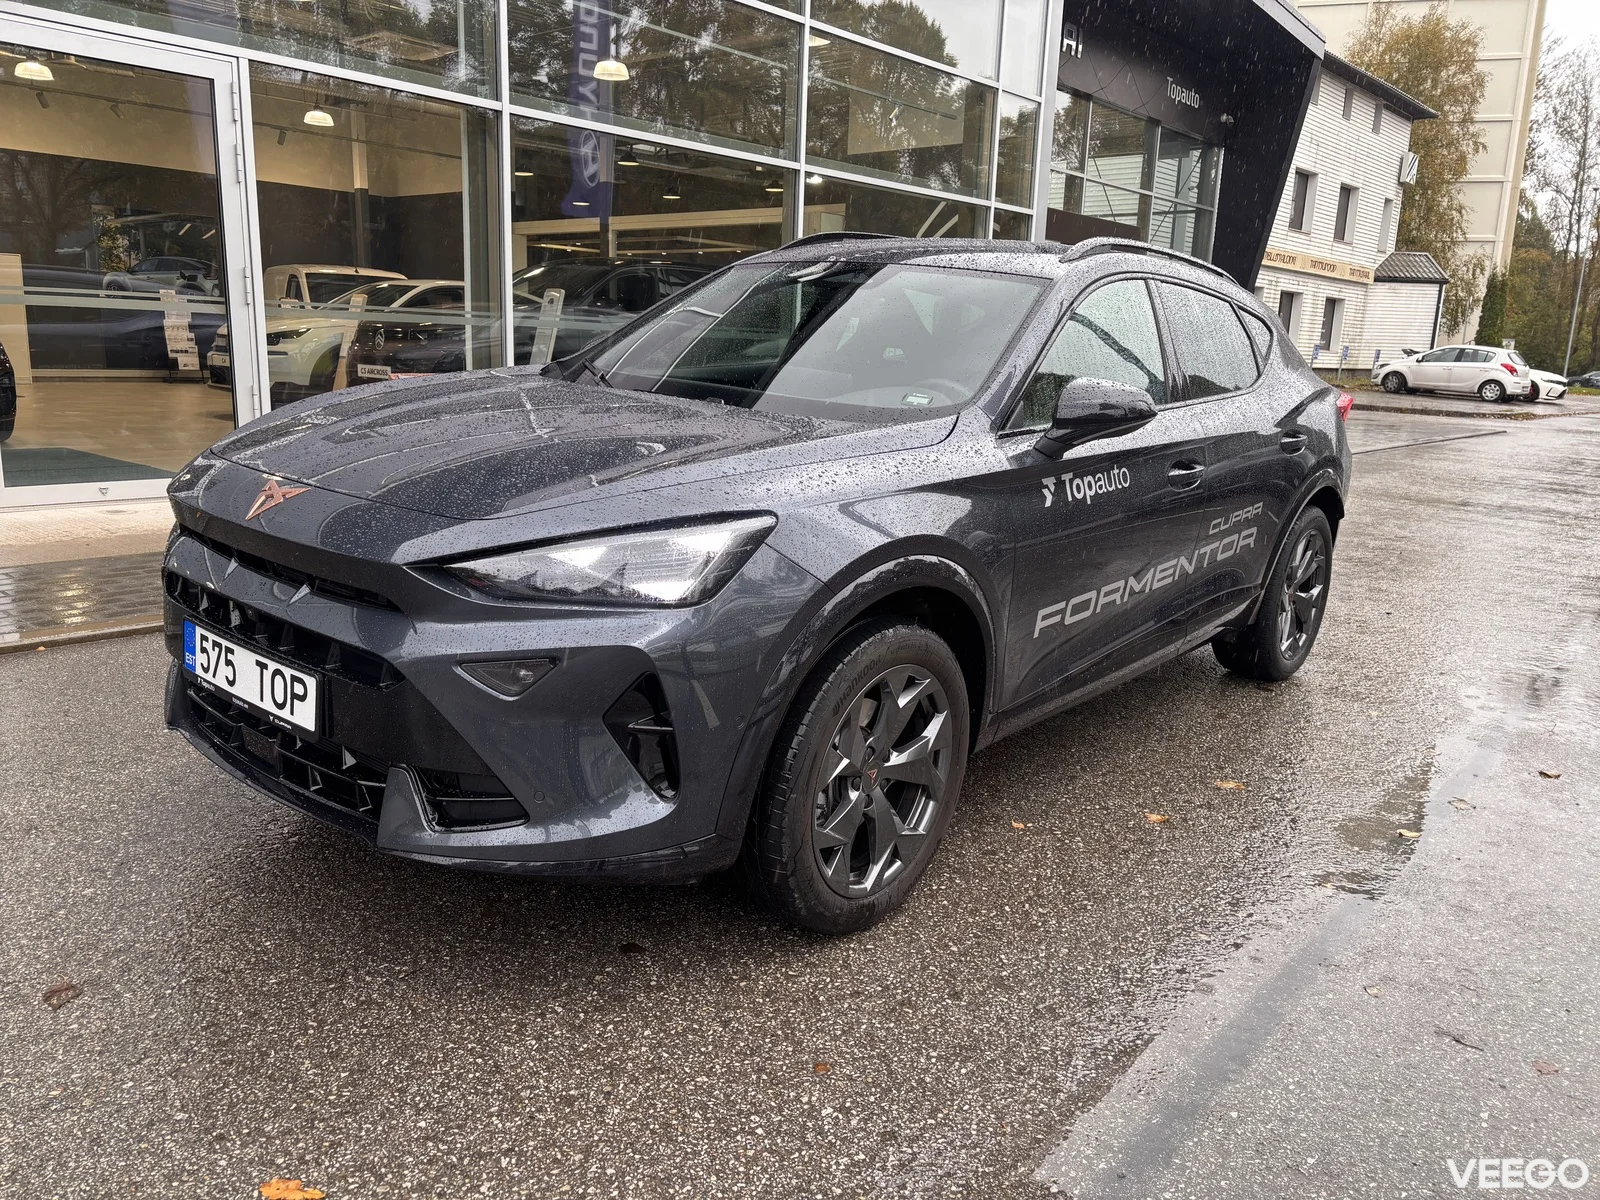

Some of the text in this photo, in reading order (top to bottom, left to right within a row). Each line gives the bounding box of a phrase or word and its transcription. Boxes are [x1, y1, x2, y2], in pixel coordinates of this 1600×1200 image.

[1166, 76, 1200, 109] Topauto
[360, 367, 388, 377] C5 AIRCROSS
[1061, 464, 1131, 505] Topauto
[1209, 502, 1264, 535] CUPRA
[1033, 526, 1258, 639] FORMENTOR
[185, 652, 196, 667] EST
[200, 632, 308, 717] 575 TOP
